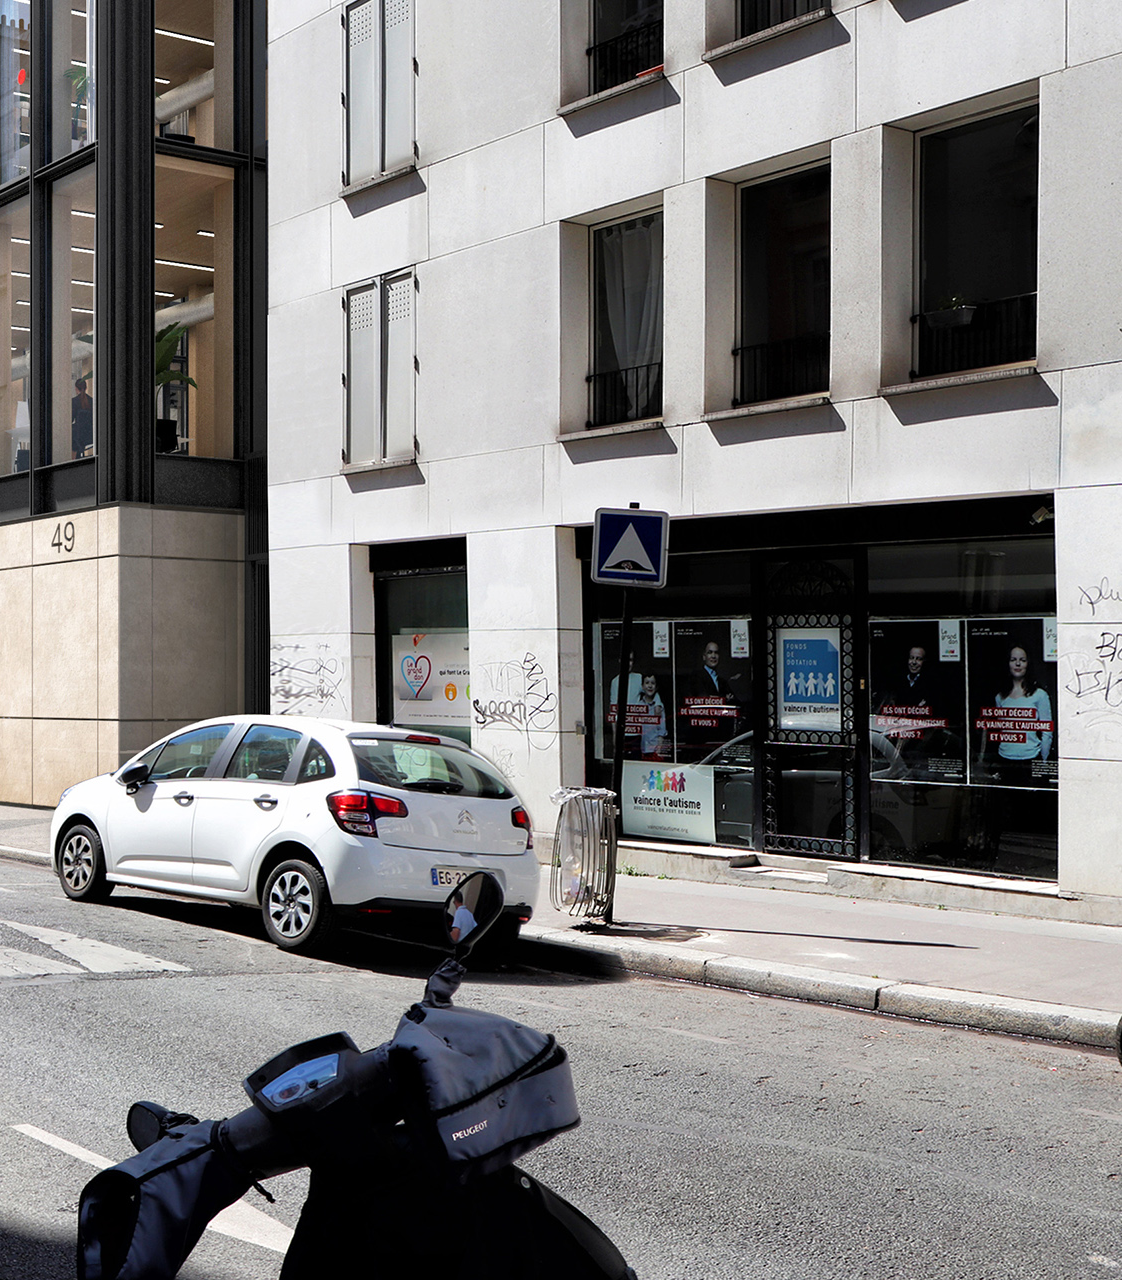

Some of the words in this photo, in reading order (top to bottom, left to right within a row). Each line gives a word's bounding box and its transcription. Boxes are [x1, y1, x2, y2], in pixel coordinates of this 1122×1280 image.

[51, 521, 75, 553] 49
[407, 666, 422, 676] grand
[809, 705, 839, 713] l'autisme
[908, 706, 929, 715] DÉCIDÉ
[1009, 708, 1033, 717] DÉCIDÉ
[1015, 722, 1051, 730] L'AUTISME
[633, 795, 661, 806] vaincre
[664, 797, 701, 809] l'autisme
[452, 1120, 488, 1141] PEUGEOT
